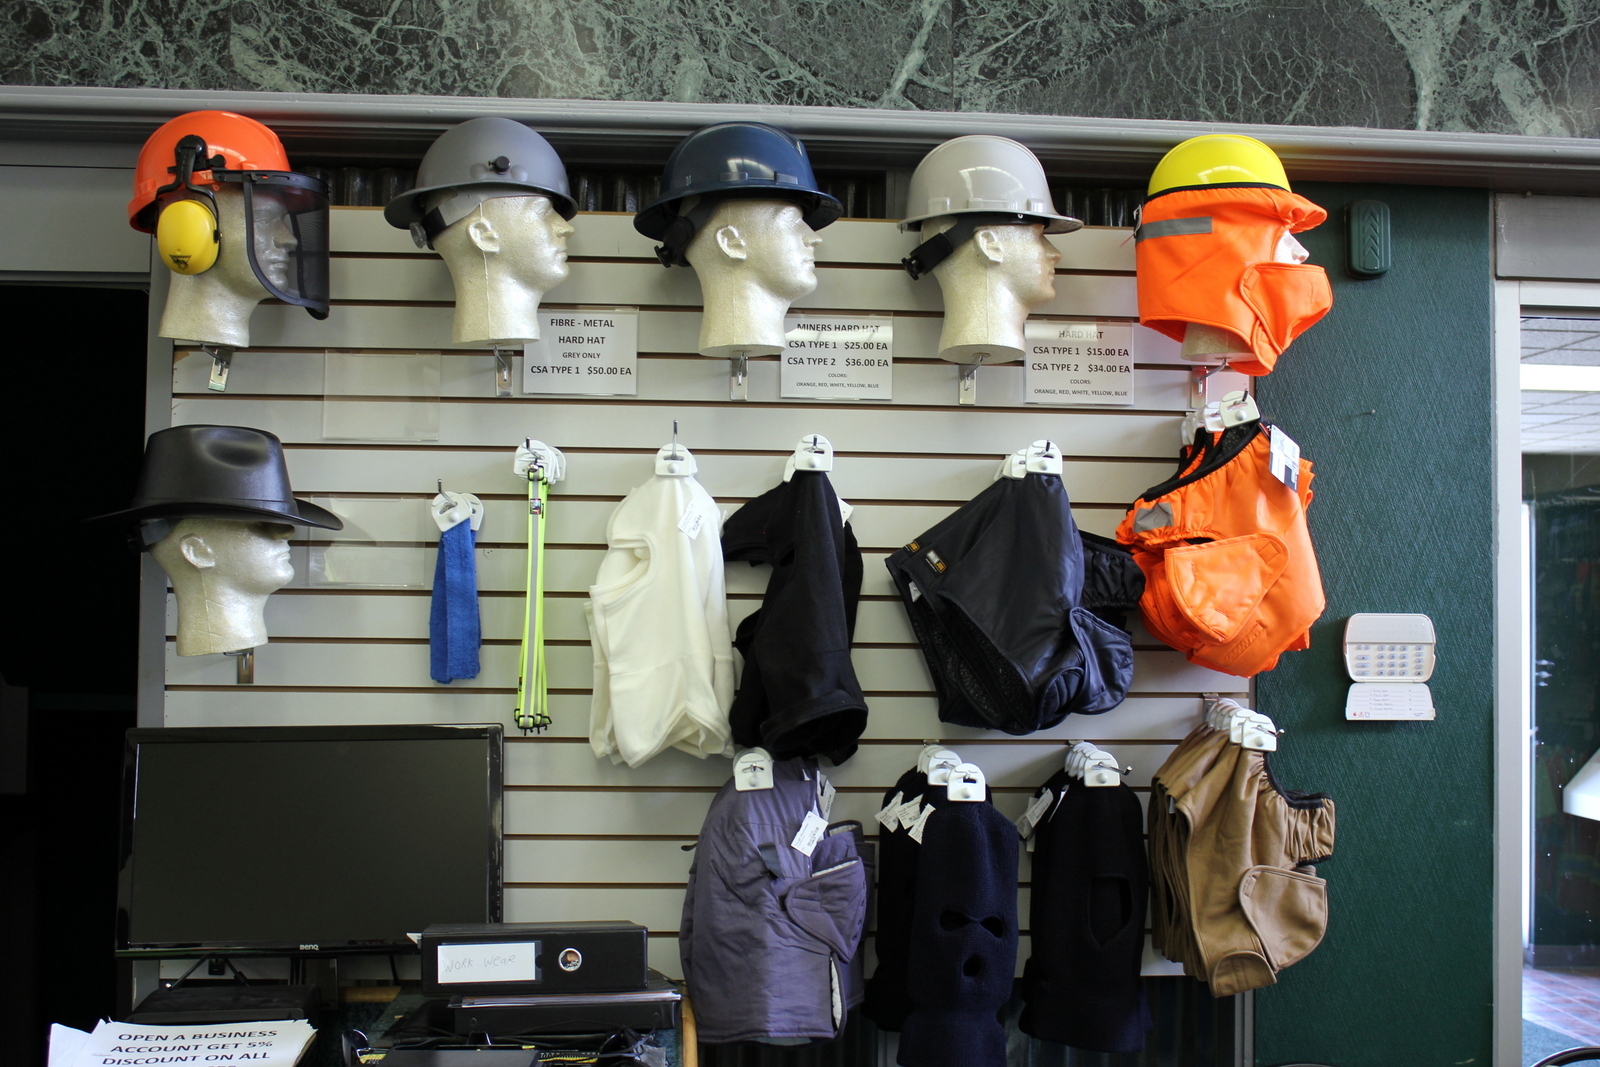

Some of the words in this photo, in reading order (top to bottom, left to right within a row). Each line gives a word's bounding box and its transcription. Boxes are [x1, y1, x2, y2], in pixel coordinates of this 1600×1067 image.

[1059, 330, 1083, 338] HARD
[844, 341, 874, 350] $25.00
[1087, 347, 1115, 356] $15.00
[846, 358, 875, 367] $36.00
[587, 366, 618, 376] $50.00
[1088, 364, 1117, 373] $34.00
[192, 1031, 277, 1039] BUSINESS
[110, 1044, 203, 1053] ACCOUNT
[102, 1055, 200, 1065] DISCOUNT
